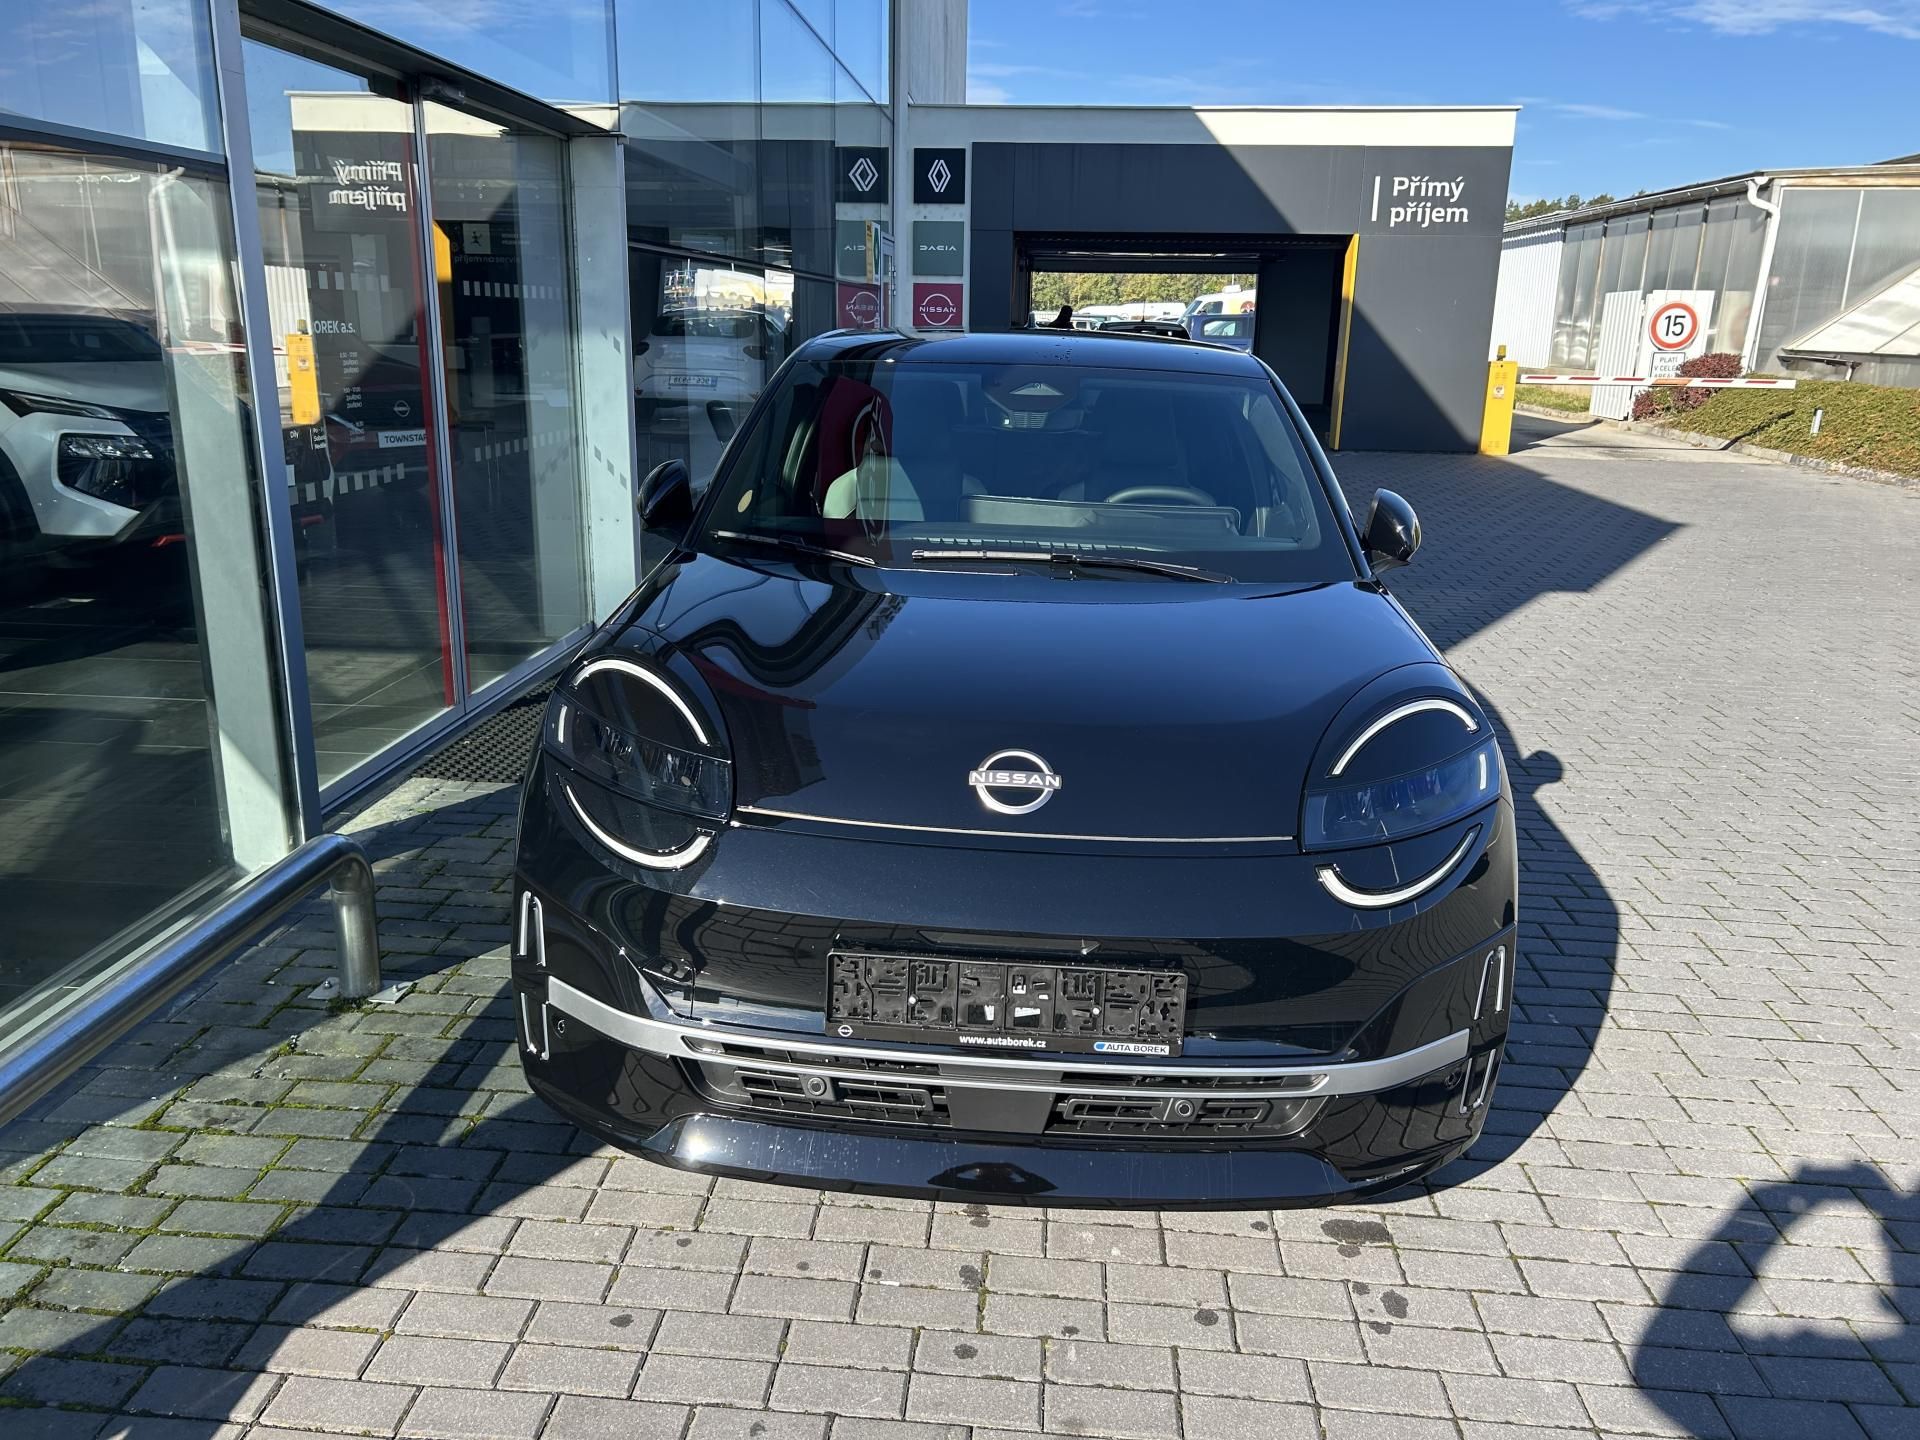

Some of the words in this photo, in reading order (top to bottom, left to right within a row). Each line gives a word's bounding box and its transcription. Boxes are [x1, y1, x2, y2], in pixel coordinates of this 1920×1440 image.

[1392, 175, 1465, 203] Přímý
[1389, 201, 1469, 228] příjem
[1664, 315, 1687, 337] 15
[970, 771, 1060, 787] NISSAN
[959, 1035, 1047, 1048] www.autaborek.cz
[1106, 1043, 1131, 1052] AUTA
[1133, 1045, 1167, 1054] BOREK
